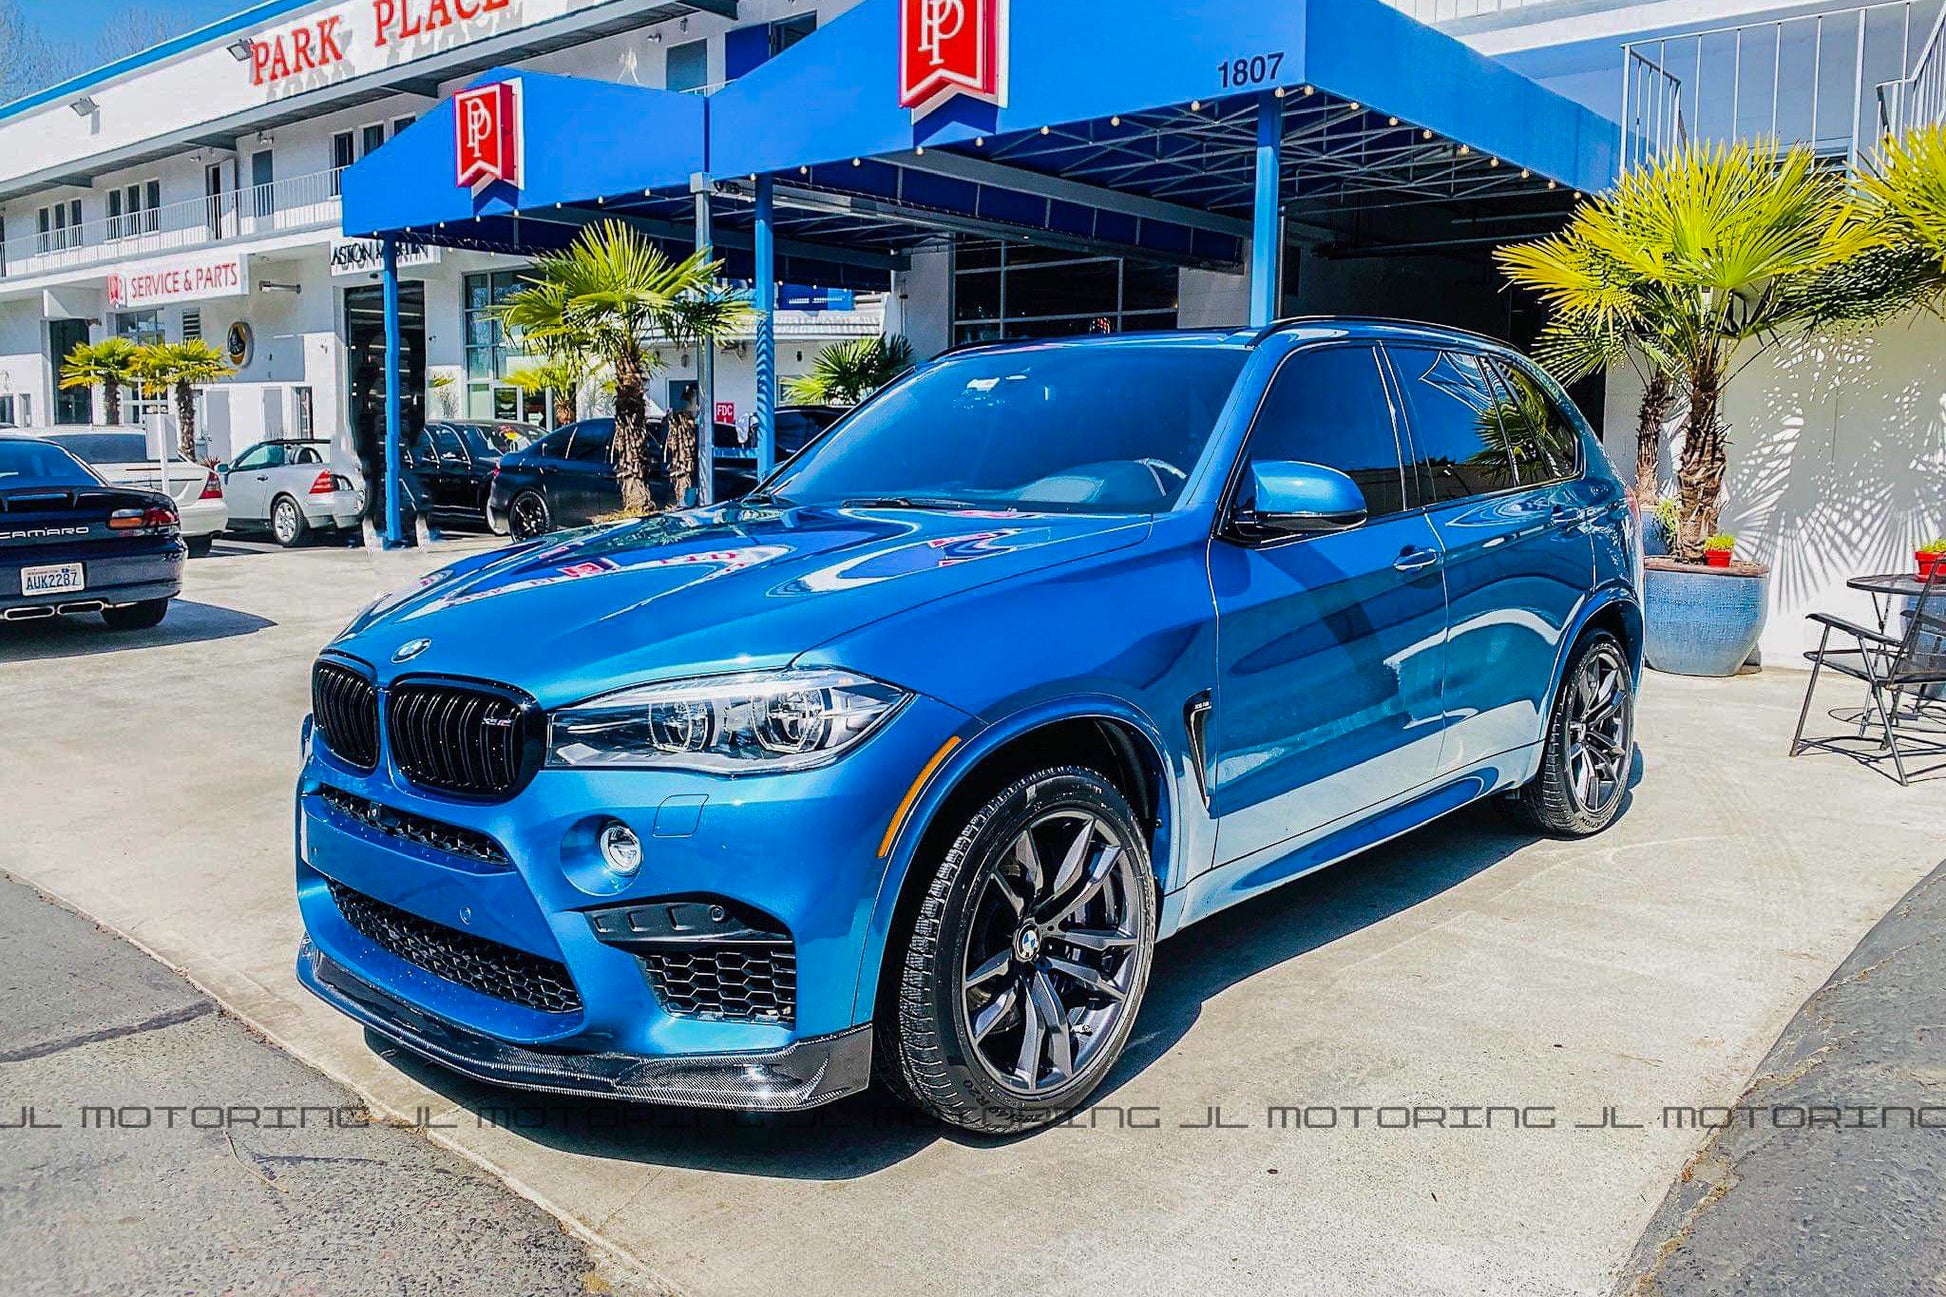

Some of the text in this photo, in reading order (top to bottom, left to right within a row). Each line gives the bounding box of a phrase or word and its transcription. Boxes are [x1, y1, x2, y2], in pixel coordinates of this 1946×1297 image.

[251, 0, 510, 86] PARK PLA
[1217, 52, 1285, 88] 1807
[330, 241, 375, 266] ASTON
[131, 271, 180, 299] SERVICE
[183, 269, 192, 292] &
[195, 263, 238, 290] PARTS
[716, 403, 734, 417] FDC
[26, 571, 77, 590] AUK2287
